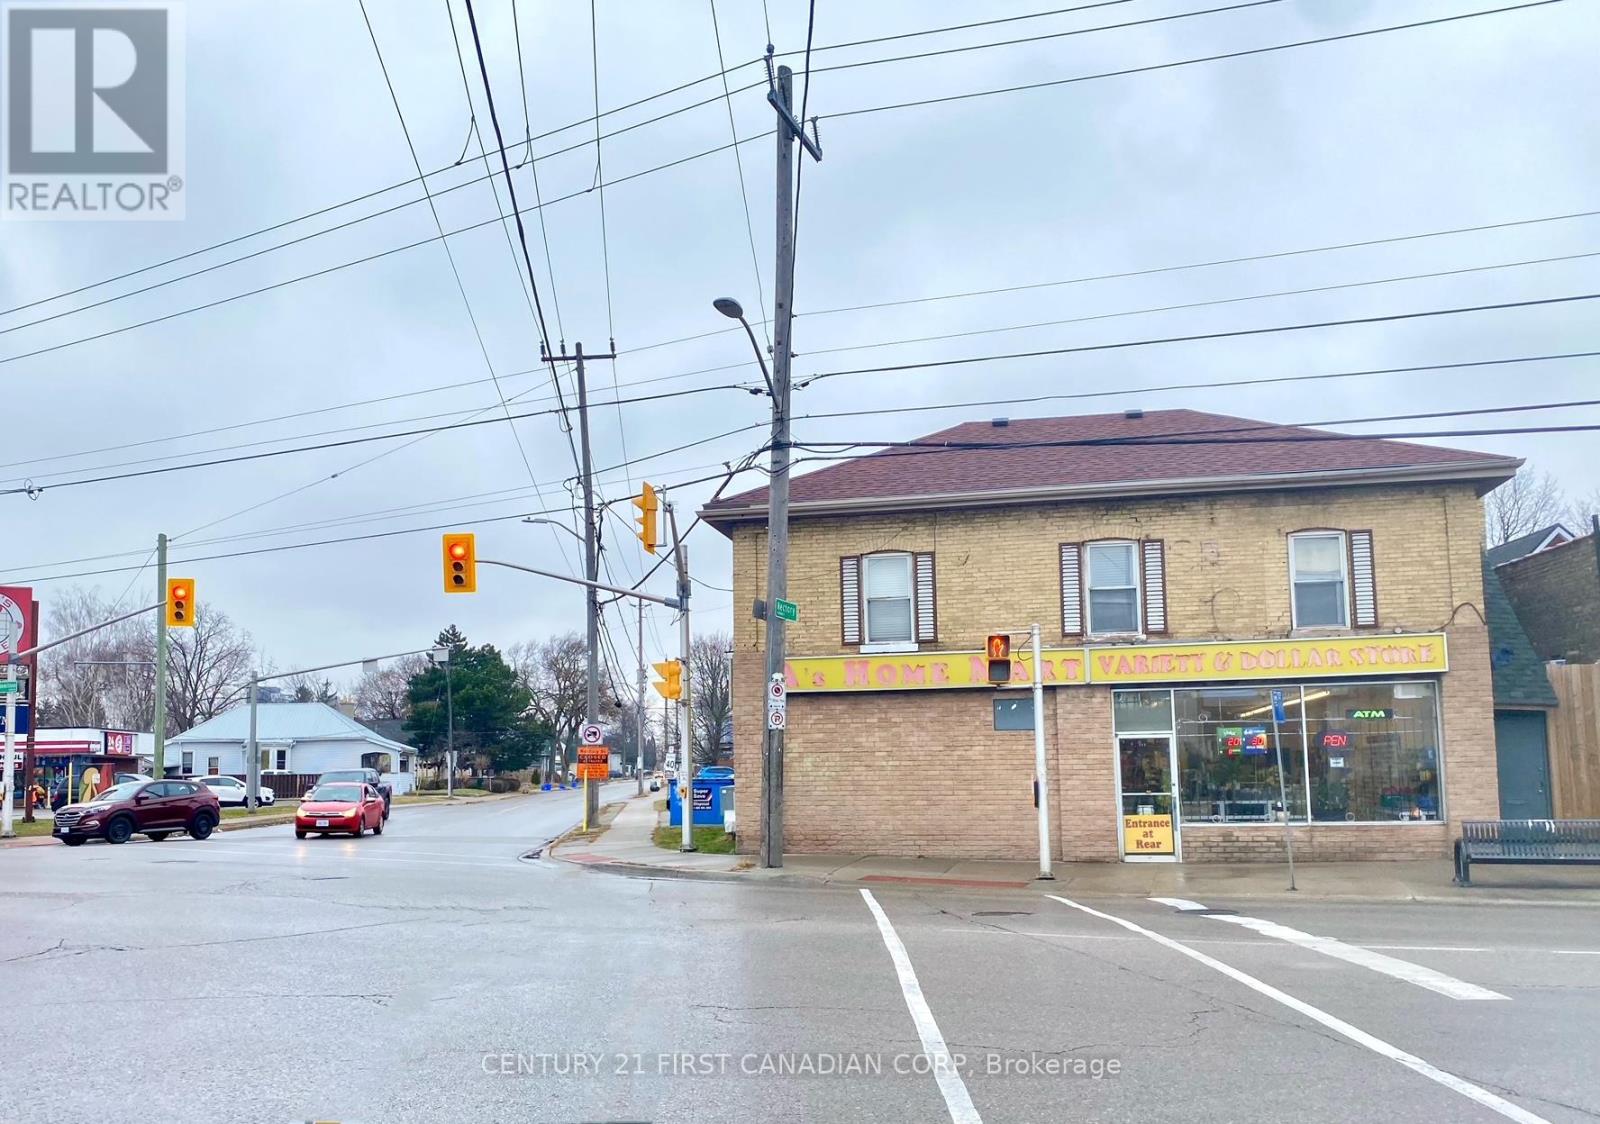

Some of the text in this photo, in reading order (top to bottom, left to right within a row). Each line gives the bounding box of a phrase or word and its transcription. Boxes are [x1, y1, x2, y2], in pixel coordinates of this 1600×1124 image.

[1098, 642, 1437, 675] VARIETY & DOLLAR STORE
[844, 660, 950, 686] HOME
[1353, 710, 1386, 718] ATM
[1125, 818, 1170, 828] Entrance
[1142, 830, 1154, 838] at
[1136, 839, 1162, 849] Rear
